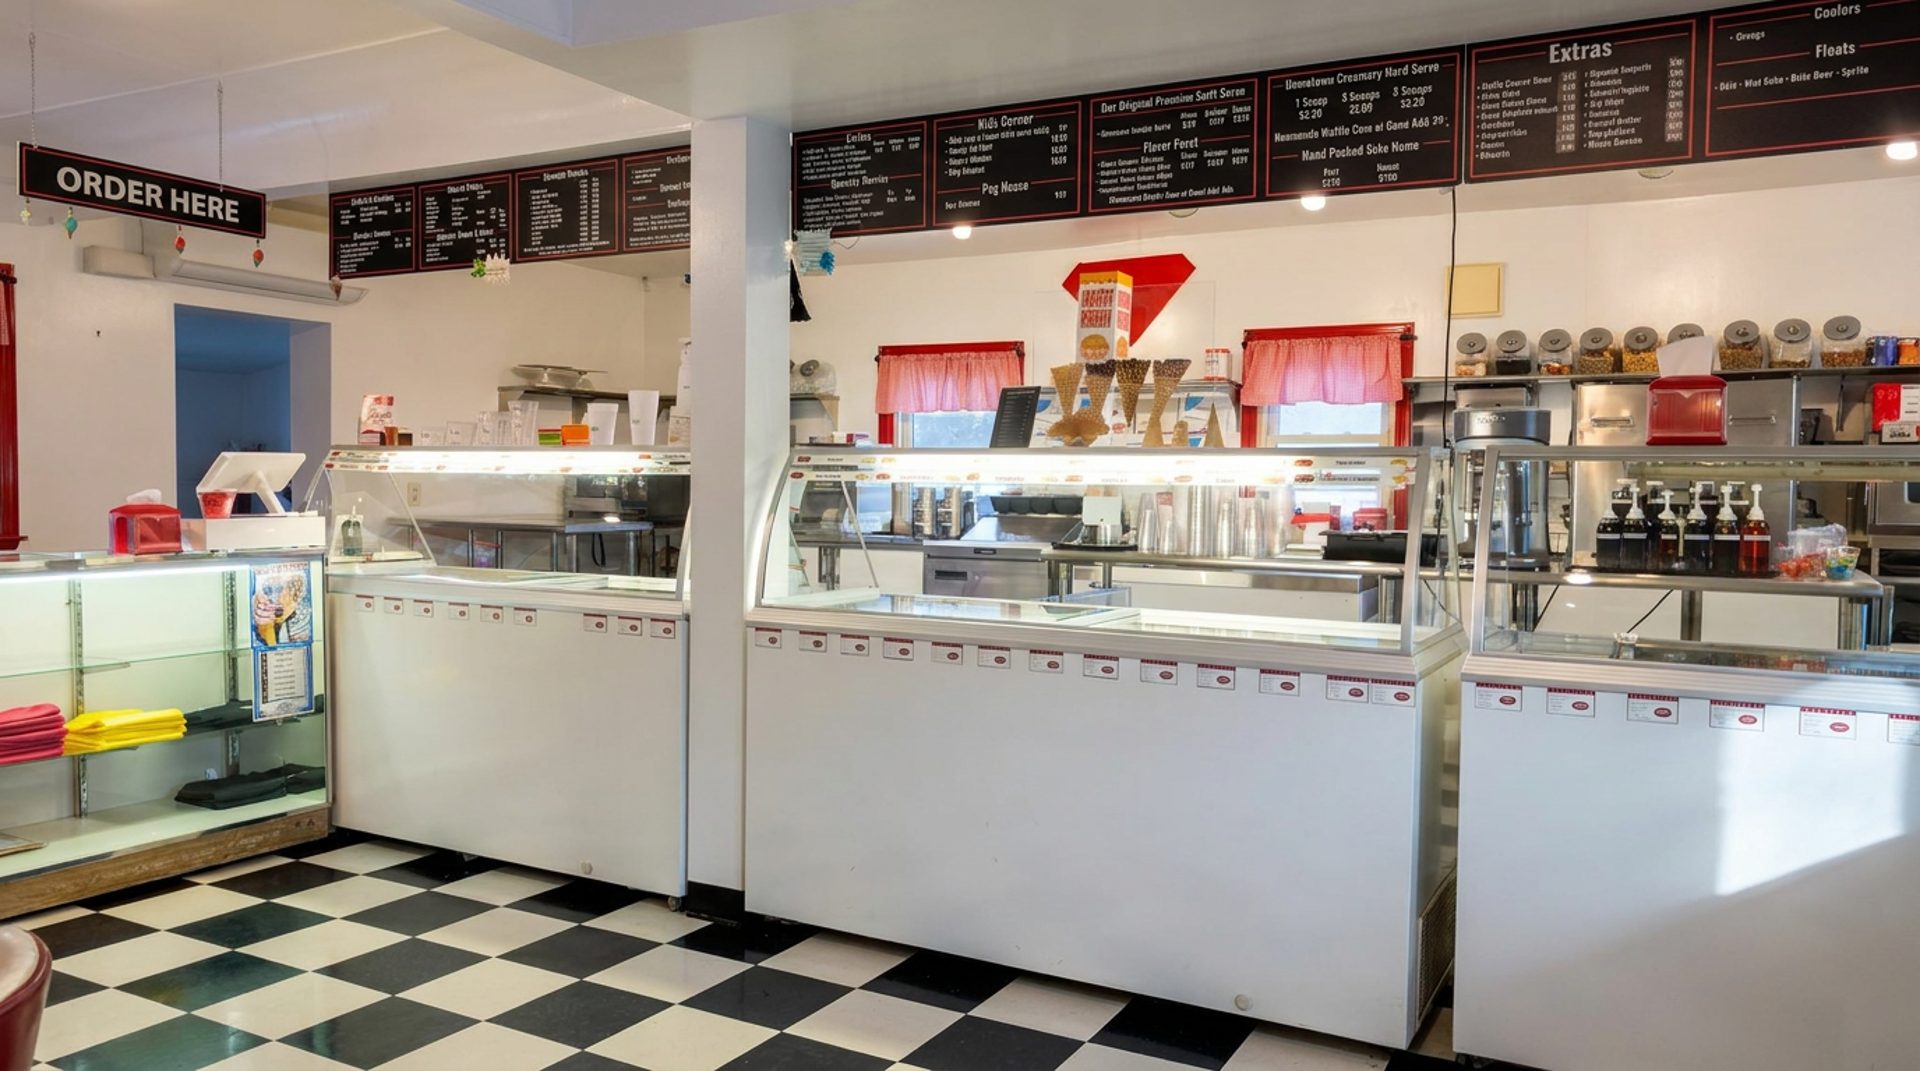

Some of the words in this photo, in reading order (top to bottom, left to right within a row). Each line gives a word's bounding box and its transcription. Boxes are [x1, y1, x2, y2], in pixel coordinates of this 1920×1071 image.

[1549, 42, 1613, 64] Extras
[57, 166, 164, 209] ORDER
[170, 188, 240, 223] HERE
